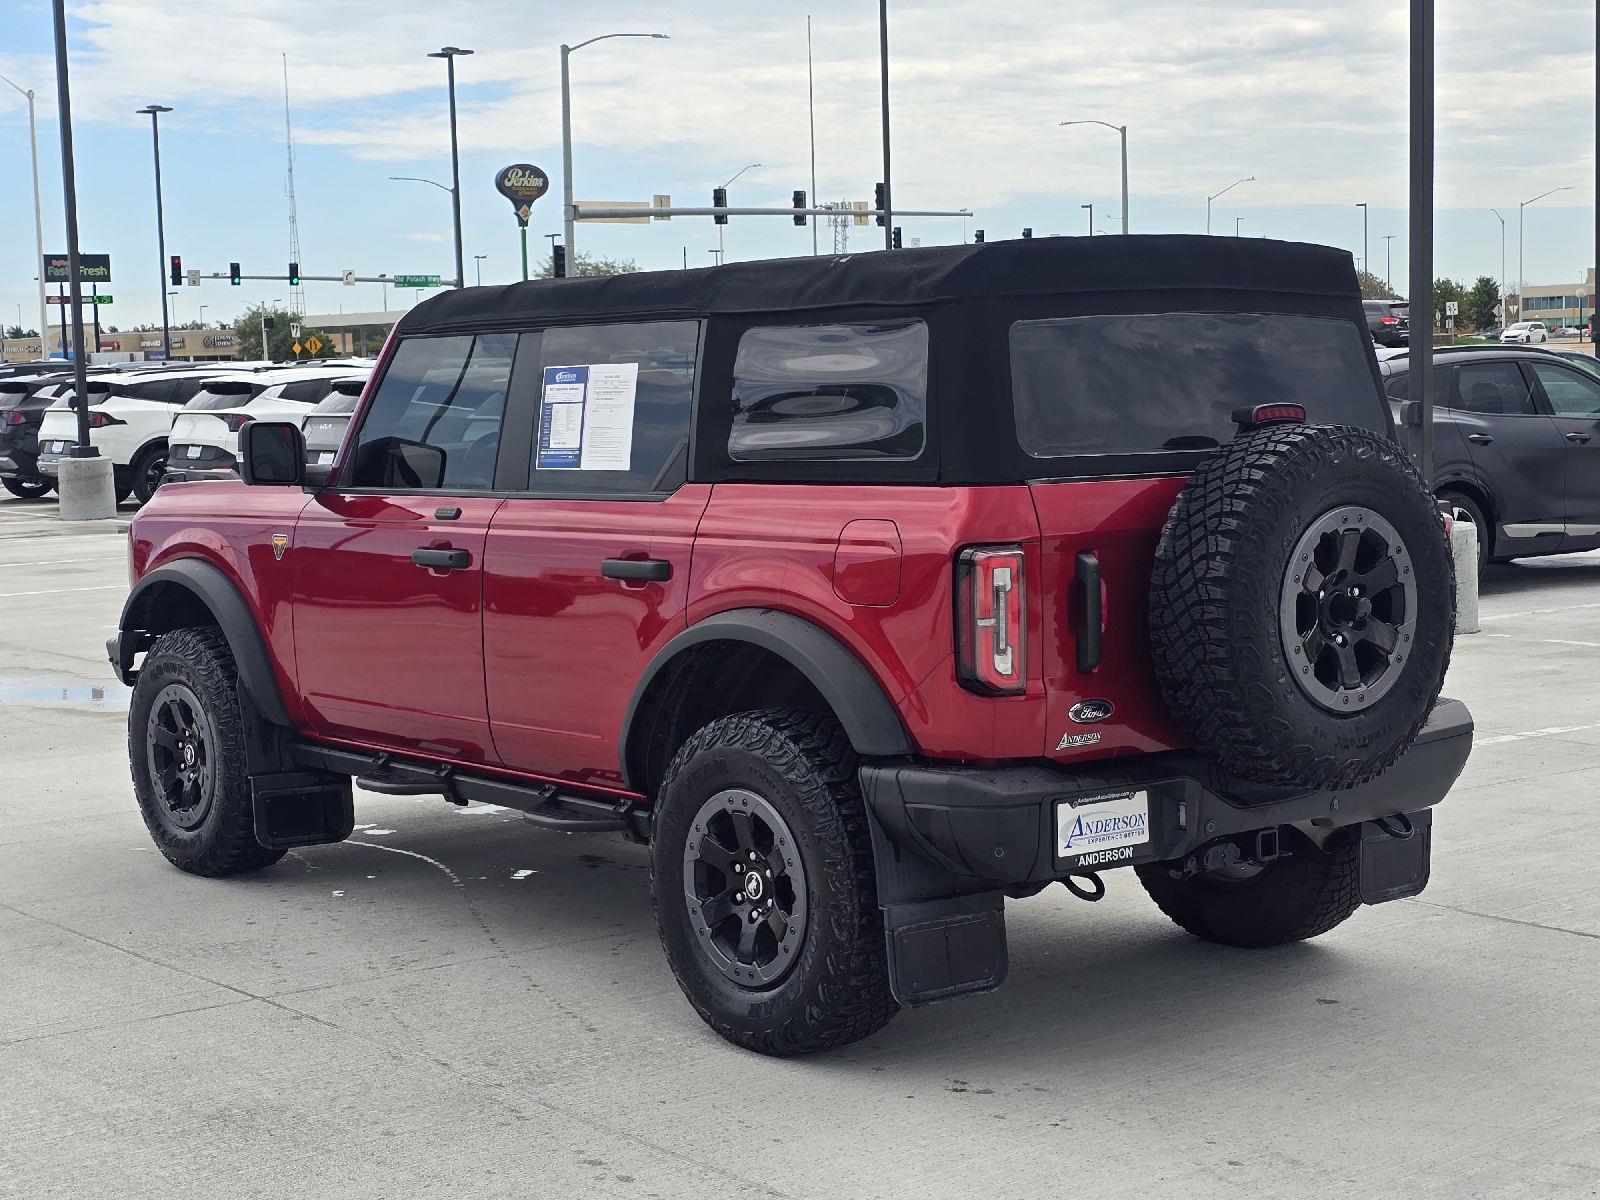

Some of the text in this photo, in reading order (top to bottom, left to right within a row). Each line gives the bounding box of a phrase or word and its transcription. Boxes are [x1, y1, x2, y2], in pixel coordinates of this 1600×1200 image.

[504, 168, 543, 187] Perkins
[79, 265, 108, 276] Fresh
[1080, 705, 1104, 719] Ford
[1056, 731, 1102, 751] ANDERSON
[1064, 812, 1147, 849] ANDERSON
[1088, 829, 1145, 845] EXPERIENCE BETTER
[1078, 846, 1134, 867] ANDERSON
